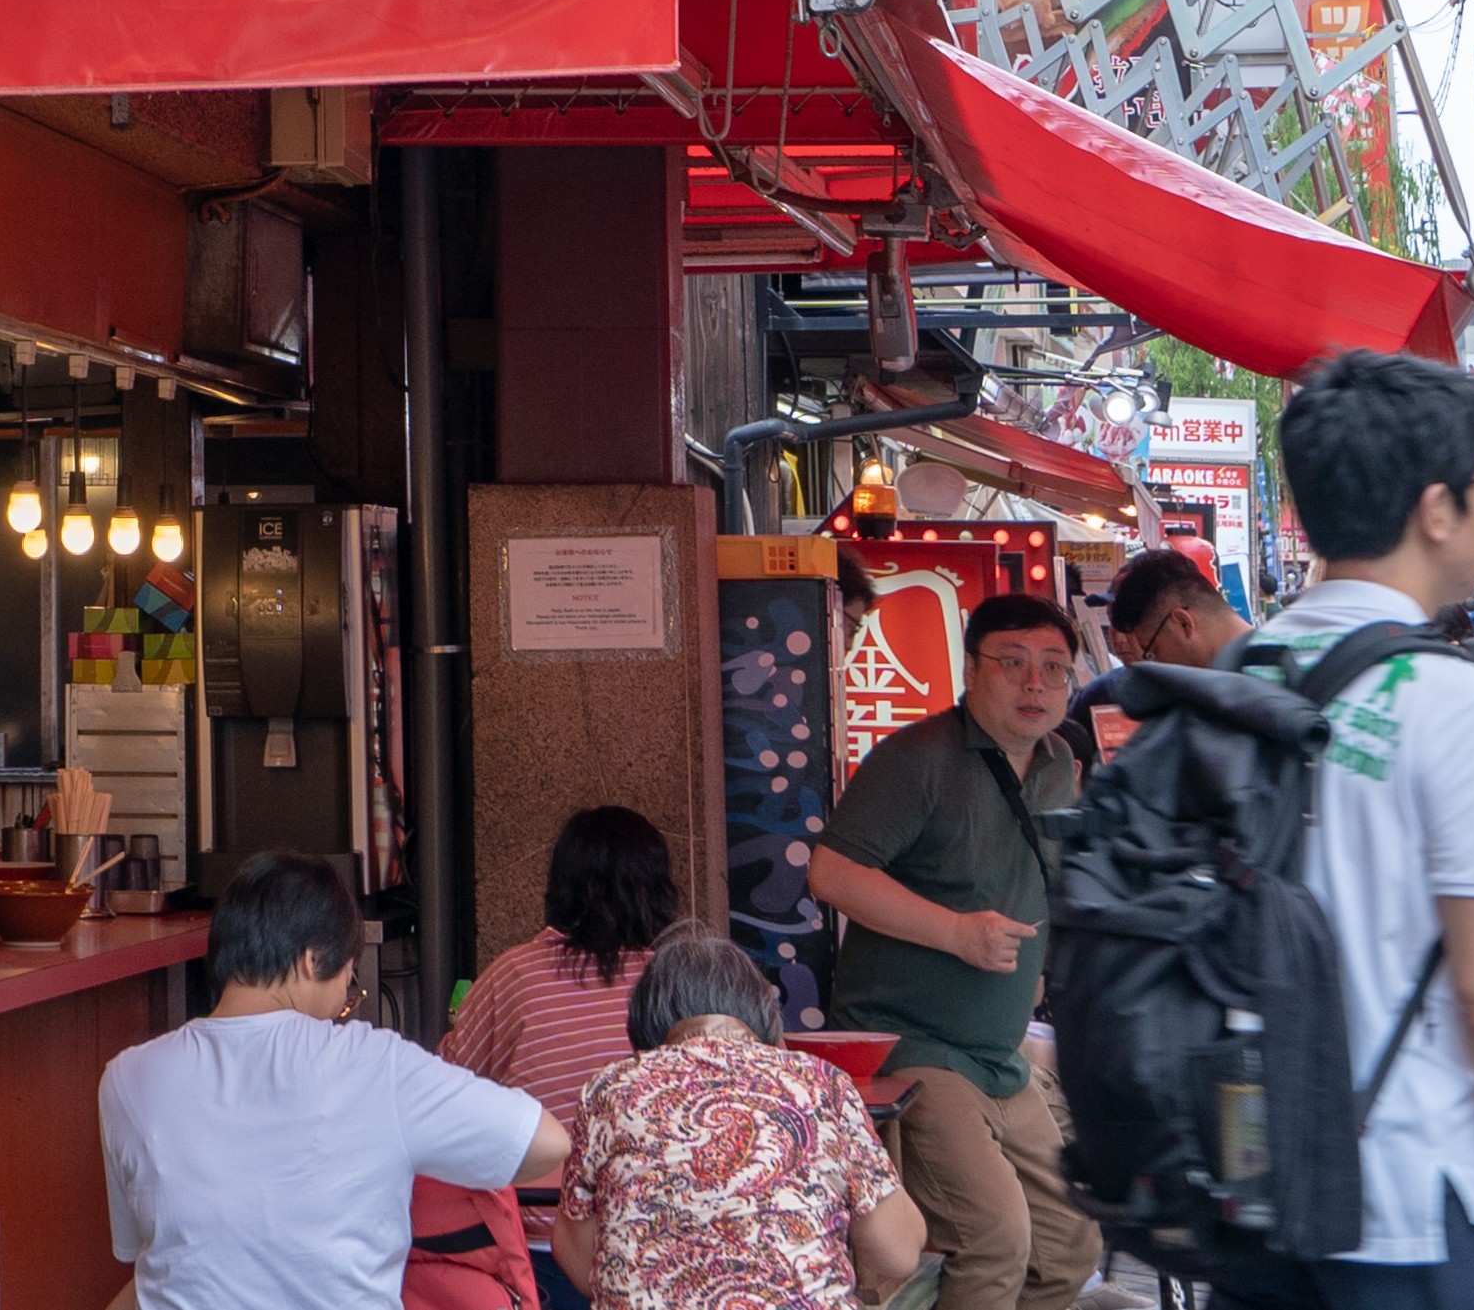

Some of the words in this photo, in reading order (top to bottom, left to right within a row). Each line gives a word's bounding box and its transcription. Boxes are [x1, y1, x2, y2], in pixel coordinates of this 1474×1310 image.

[1150, 419, 1243, 444] 4h営業中
[259, 522, 283, 535] ICE
